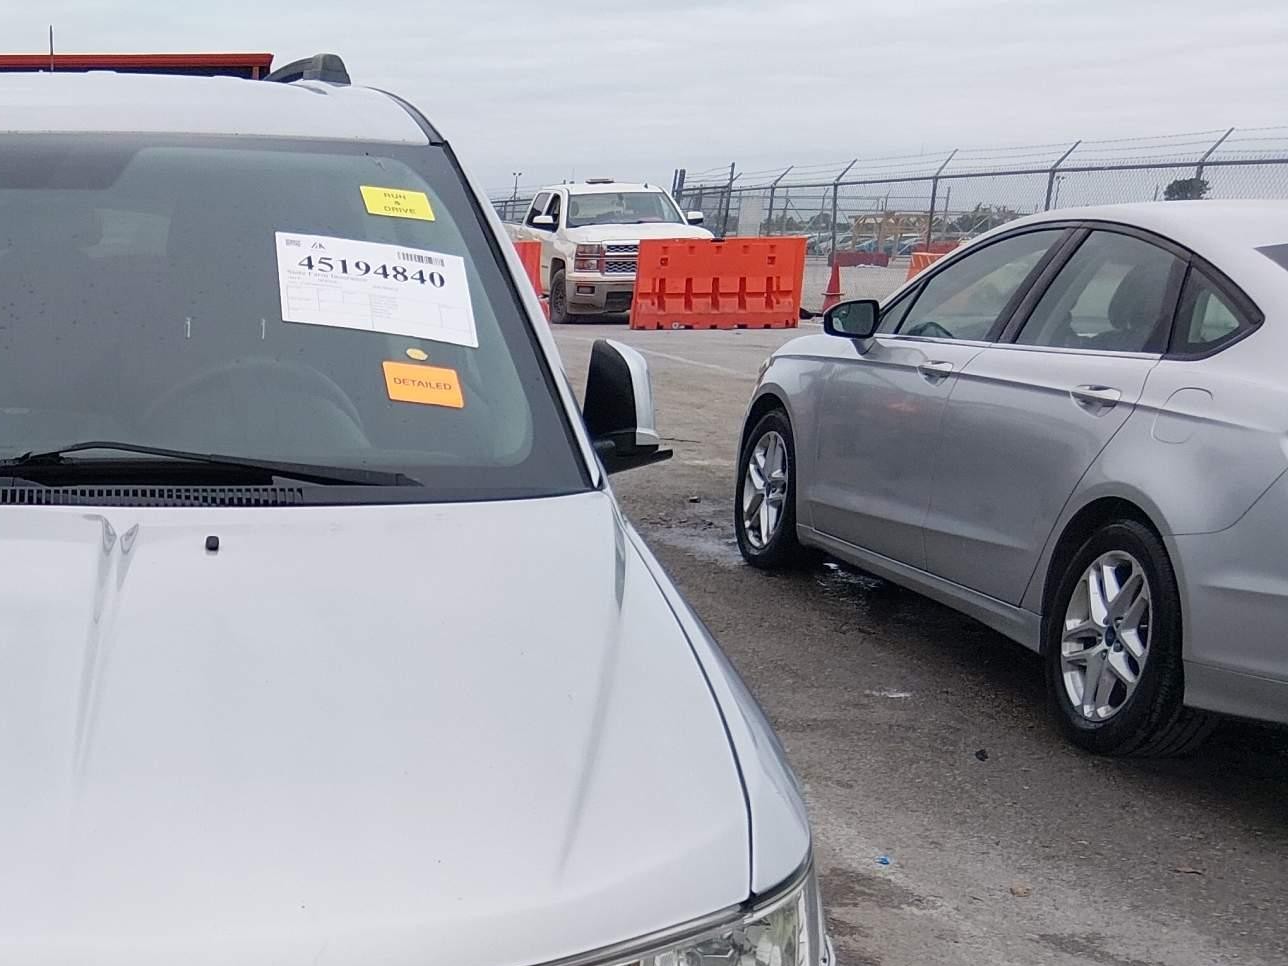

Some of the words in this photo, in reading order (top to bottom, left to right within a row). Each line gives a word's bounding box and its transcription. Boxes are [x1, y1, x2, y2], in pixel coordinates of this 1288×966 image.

[383, 205, 417, 215] DRIVE
[298, 255, 446, 289] 45194840
[393, 376, 452, 392] DETAILED
